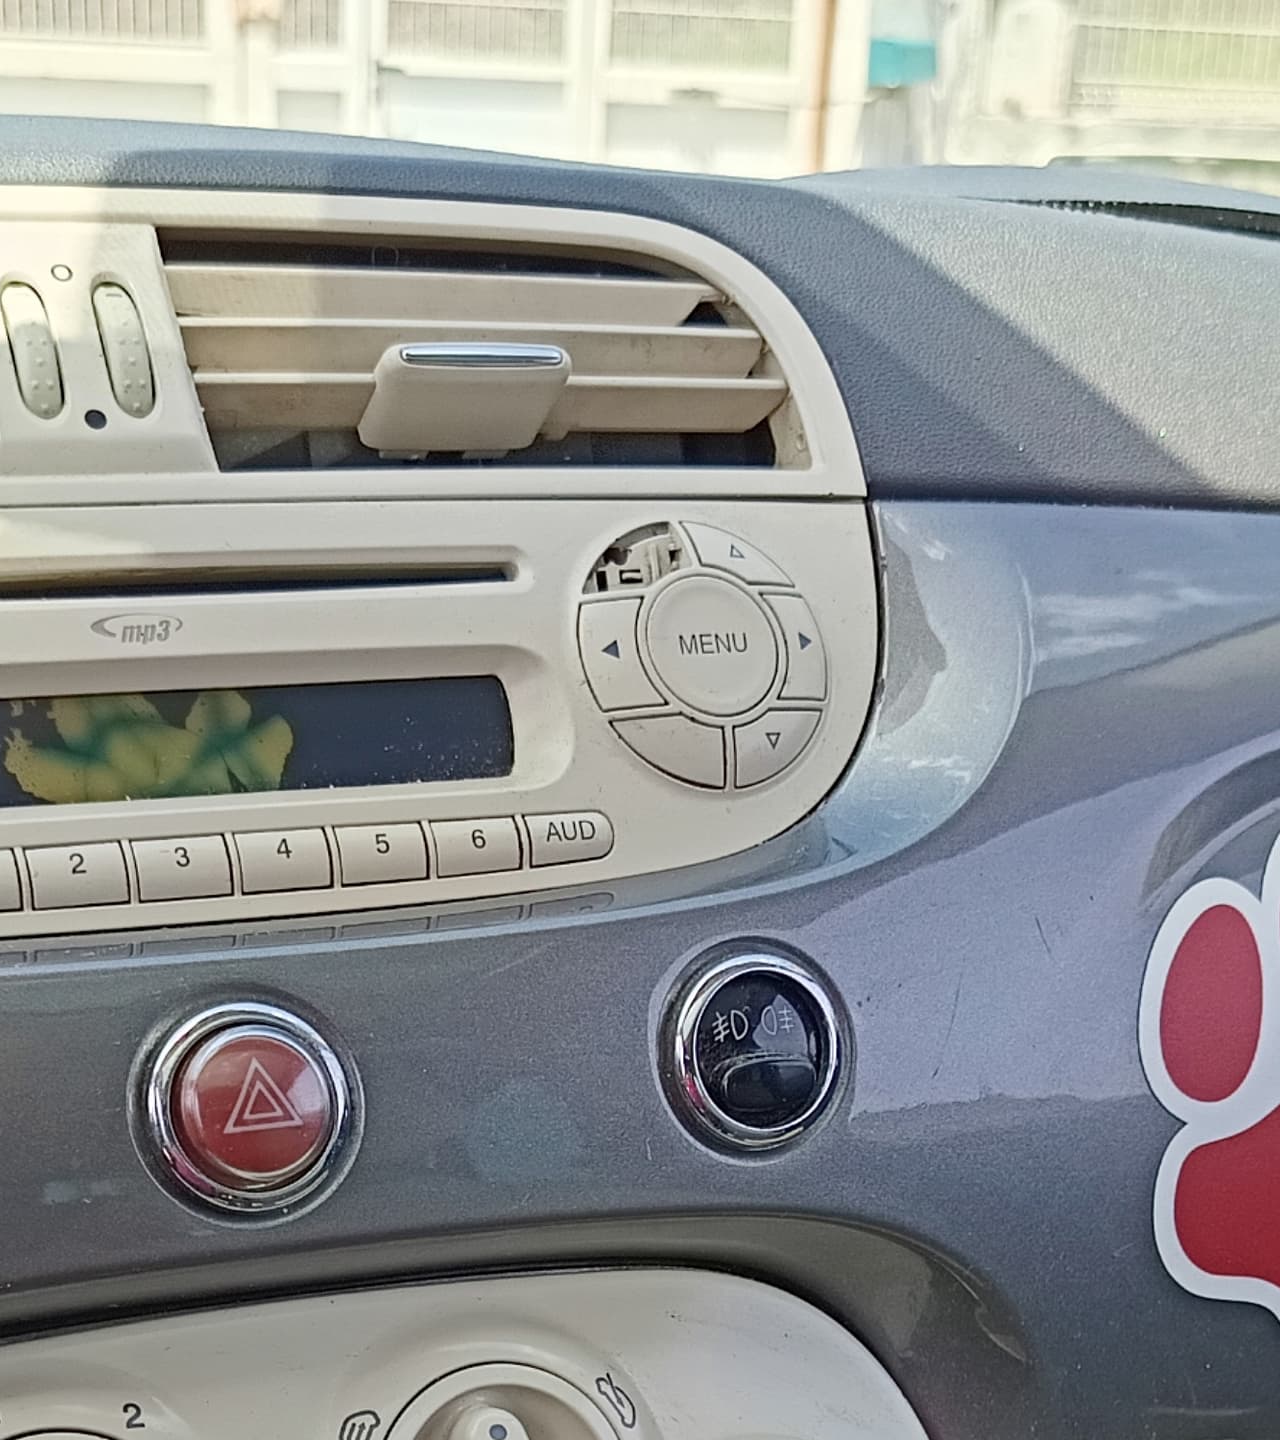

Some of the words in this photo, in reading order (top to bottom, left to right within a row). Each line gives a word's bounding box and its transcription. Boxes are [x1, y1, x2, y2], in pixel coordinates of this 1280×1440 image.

[121, 619, 171, 645] mp3
[679, 632, 747, 655] MENU
[471, 829, 487, 849] 6
[546, 819, 596, 843] AUD
[276, 838, 293, 860] 4
[375, 833, 390, 854] 5
[69, 853, 87, 875] 2
[175, 847, 191, 868] 3
[122, 1403, 145, 1429] 2
